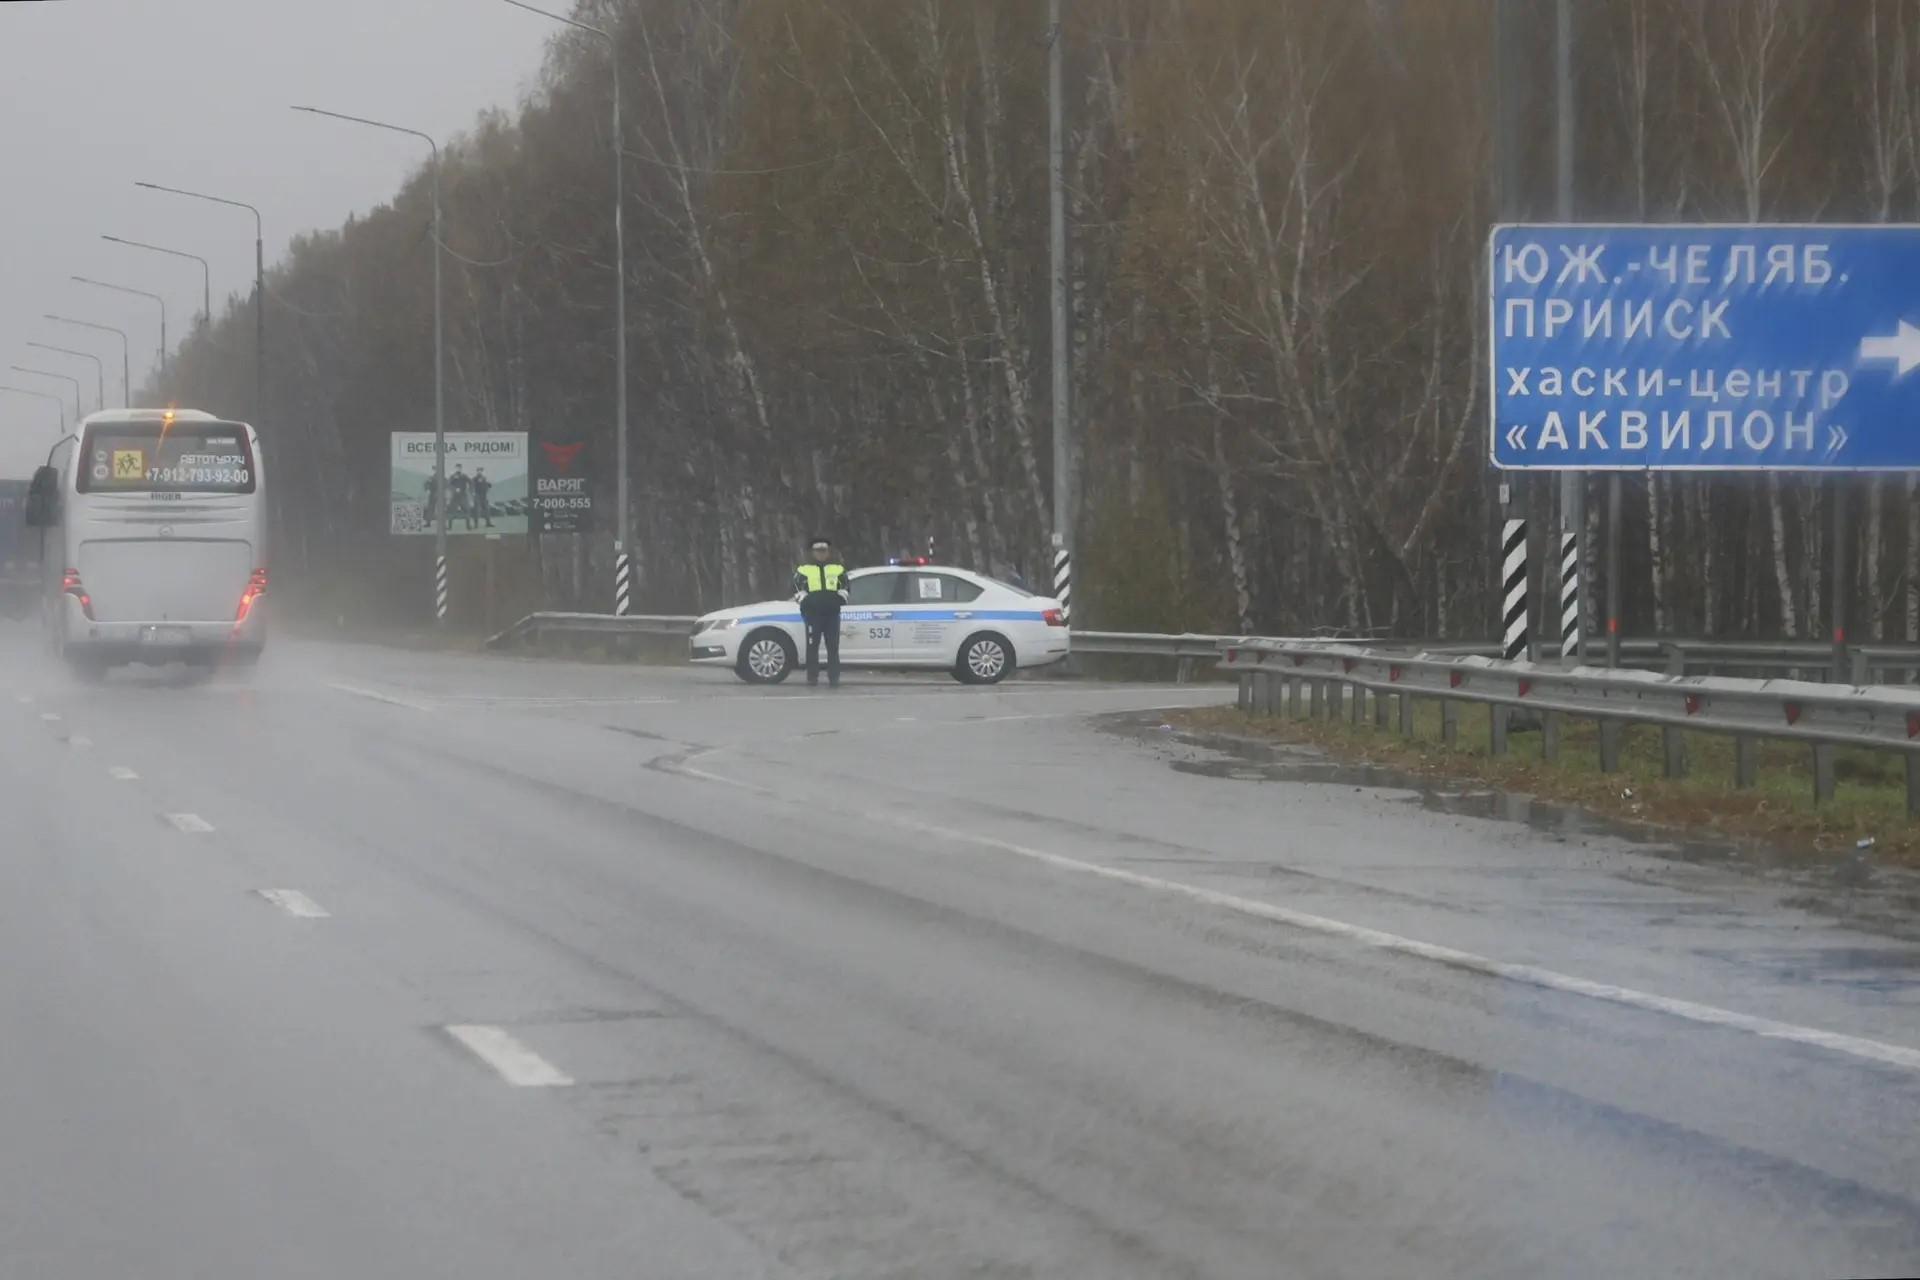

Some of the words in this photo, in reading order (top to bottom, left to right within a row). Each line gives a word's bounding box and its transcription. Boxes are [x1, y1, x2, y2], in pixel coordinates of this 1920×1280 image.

[1504, 243, 1849, 284] ЮЖ.-ЧЕЛЯБ.
[1505, 298, 1732, 339] ПРИИСК
[1506, 366, 1849, 409] хаски-центр
[1506, 409, 1849, 450] «АКВИЛОН»
[407, 442, 457, 453] ВСЕДА
[464, 441, 515, 454] РЯДОМ!
[538, 479, 585, 491] ВАРЯГ
[533, 498, 591, 509] 7-000-555
[869, 627, 892, 639] 532
